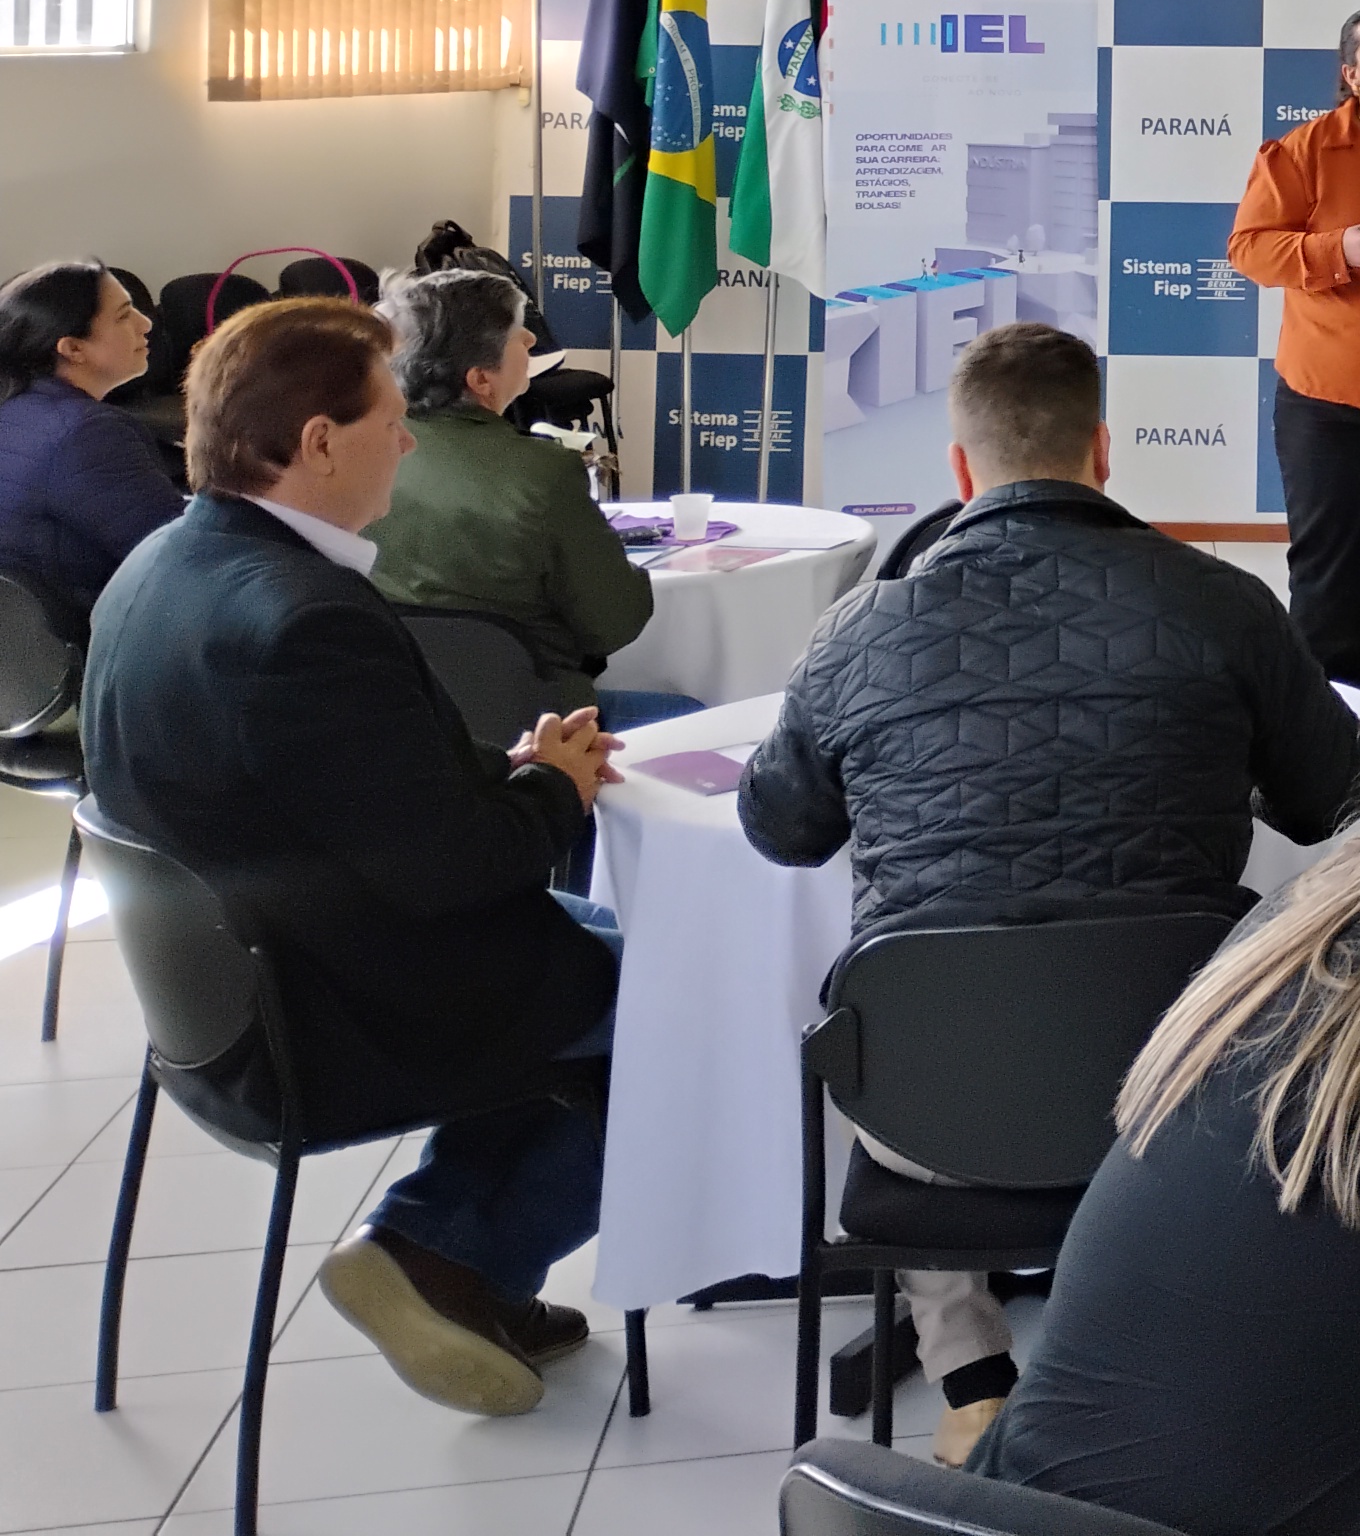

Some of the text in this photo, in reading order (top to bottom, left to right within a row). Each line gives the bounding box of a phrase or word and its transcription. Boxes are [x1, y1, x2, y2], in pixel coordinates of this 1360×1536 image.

[940, 15, 1045, 54] IEL
[786, 26, 814, 79] PARAN
[1142, 114, 1231, 136] PARANÁ
[856, 133, 952, 141] OPORTUNIDADES
[888, 144, 947, 152] COMEAR
[856, 156, 879, 164] SUA
[856, 190, 907, 198] TRAINEES
[1123, 259, 1191, 274] Sistema
[1155, 280, 1191, 299] Fiep
[700, 431, 737, 450] Fiep
[1136, 424, 1226, 446] PARANÁ
